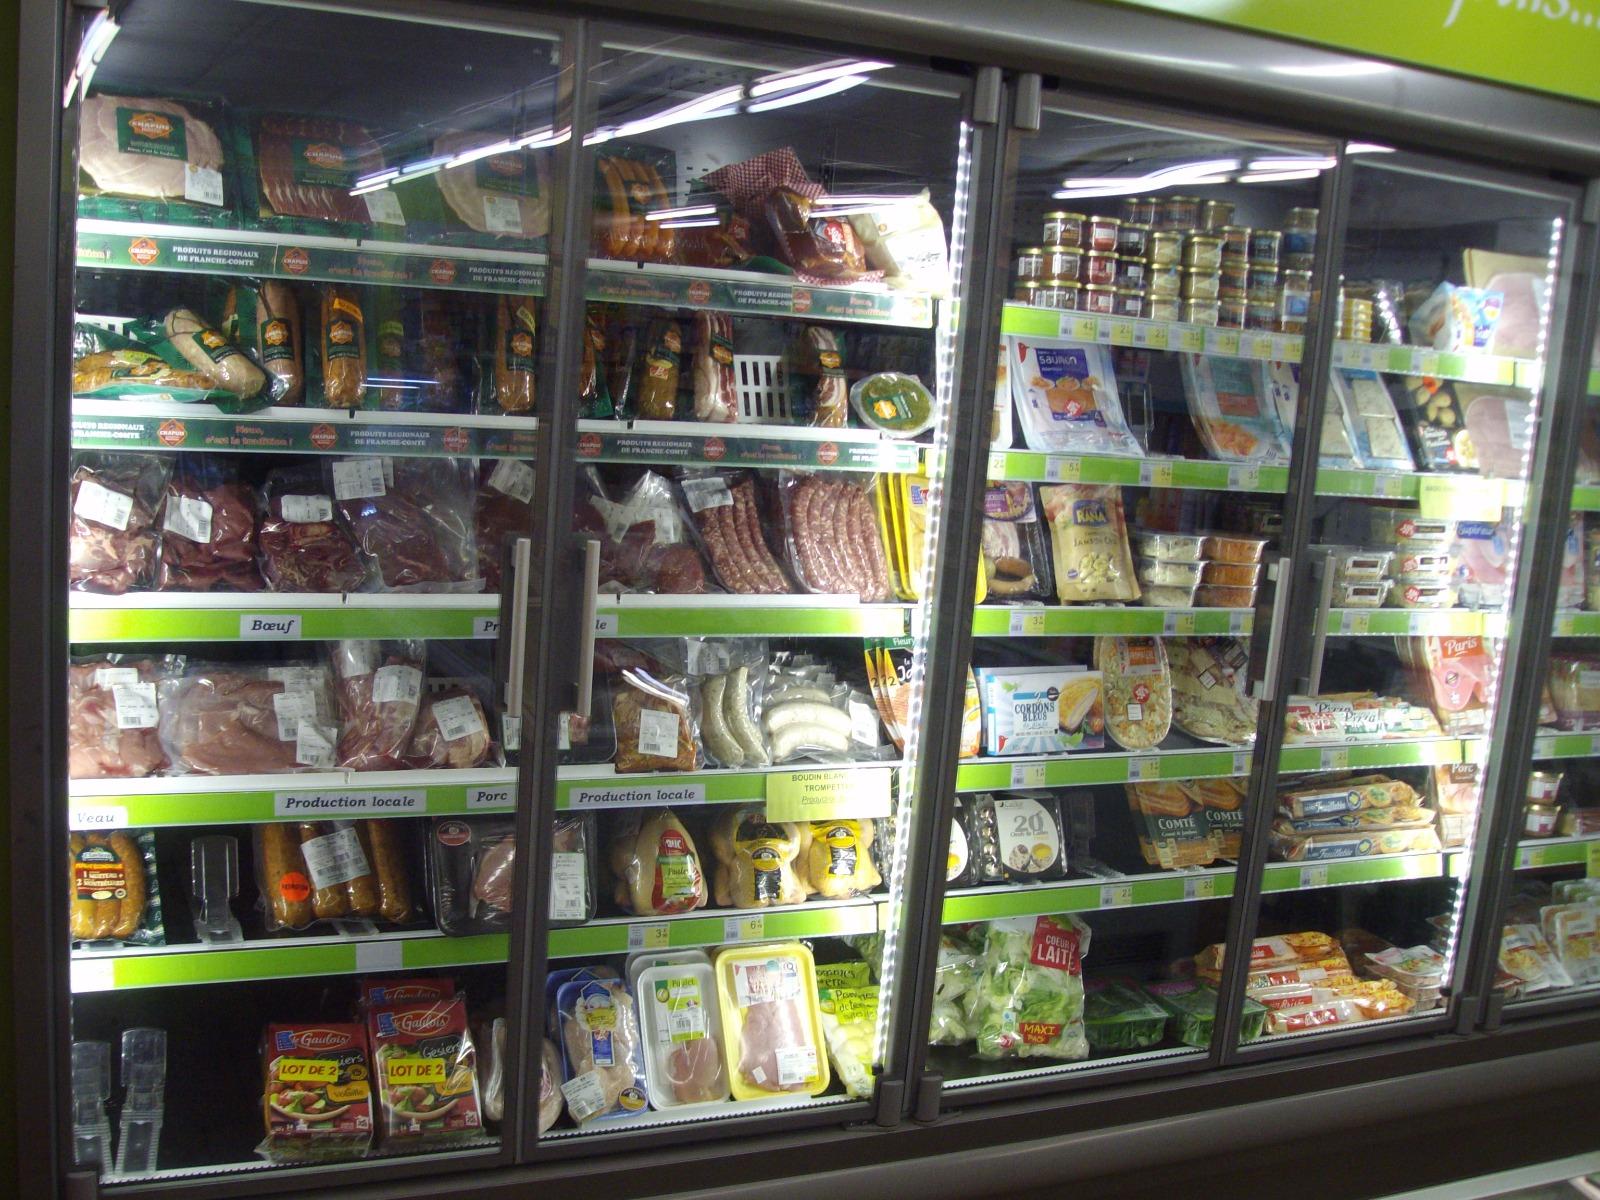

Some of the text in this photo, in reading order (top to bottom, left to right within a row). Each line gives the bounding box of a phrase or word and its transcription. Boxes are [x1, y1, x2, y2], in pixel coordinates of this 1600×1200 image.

[172, 245, 259, 259] PRODUITS REGIONAUX
[177, 254, 188, 262] DE
[468, 266, 503, 274] PRODUITS
[734, 288, 767, 299] PRODUITS
[350, 430, 430, 439] PRODUITS REGIONAUX
[617, 439, 693, 449] PRODUITS REGIONAUX
[1076, 509, 1107, 523] RANA
[1445, 637, 1478, 655] Paris
[1014, 702, 1055, 714] CORDONS
[1022, 712, 1047, 723] BLEUS
[1452, 763, 1474, 774] Porc
[791, 774, 822, 782] BOUDIN
[286, 794, 416, 810] Production locale
[476, 788, 508, 804] Porc
[578, 787, 696, 804] Production locale
[77, 812, 116, 825] Veau
[1205, 808, 1244, 821] COMTÉ
[1014, 814, 1044, 833] 20
[1157, 815, 1196, 830] COMTÉ
[401, 1014, 446, 1032] Gaulois
[1023, 1023, 1056, 1036] MAXI
[300, 1032, 350, 1047] Gaulois
[337, 1053, 365, 1067] iers
[281, 1064, 338, 1076] LOT DE 2
[390, 1064, 444, 1077] LOT DE 2
